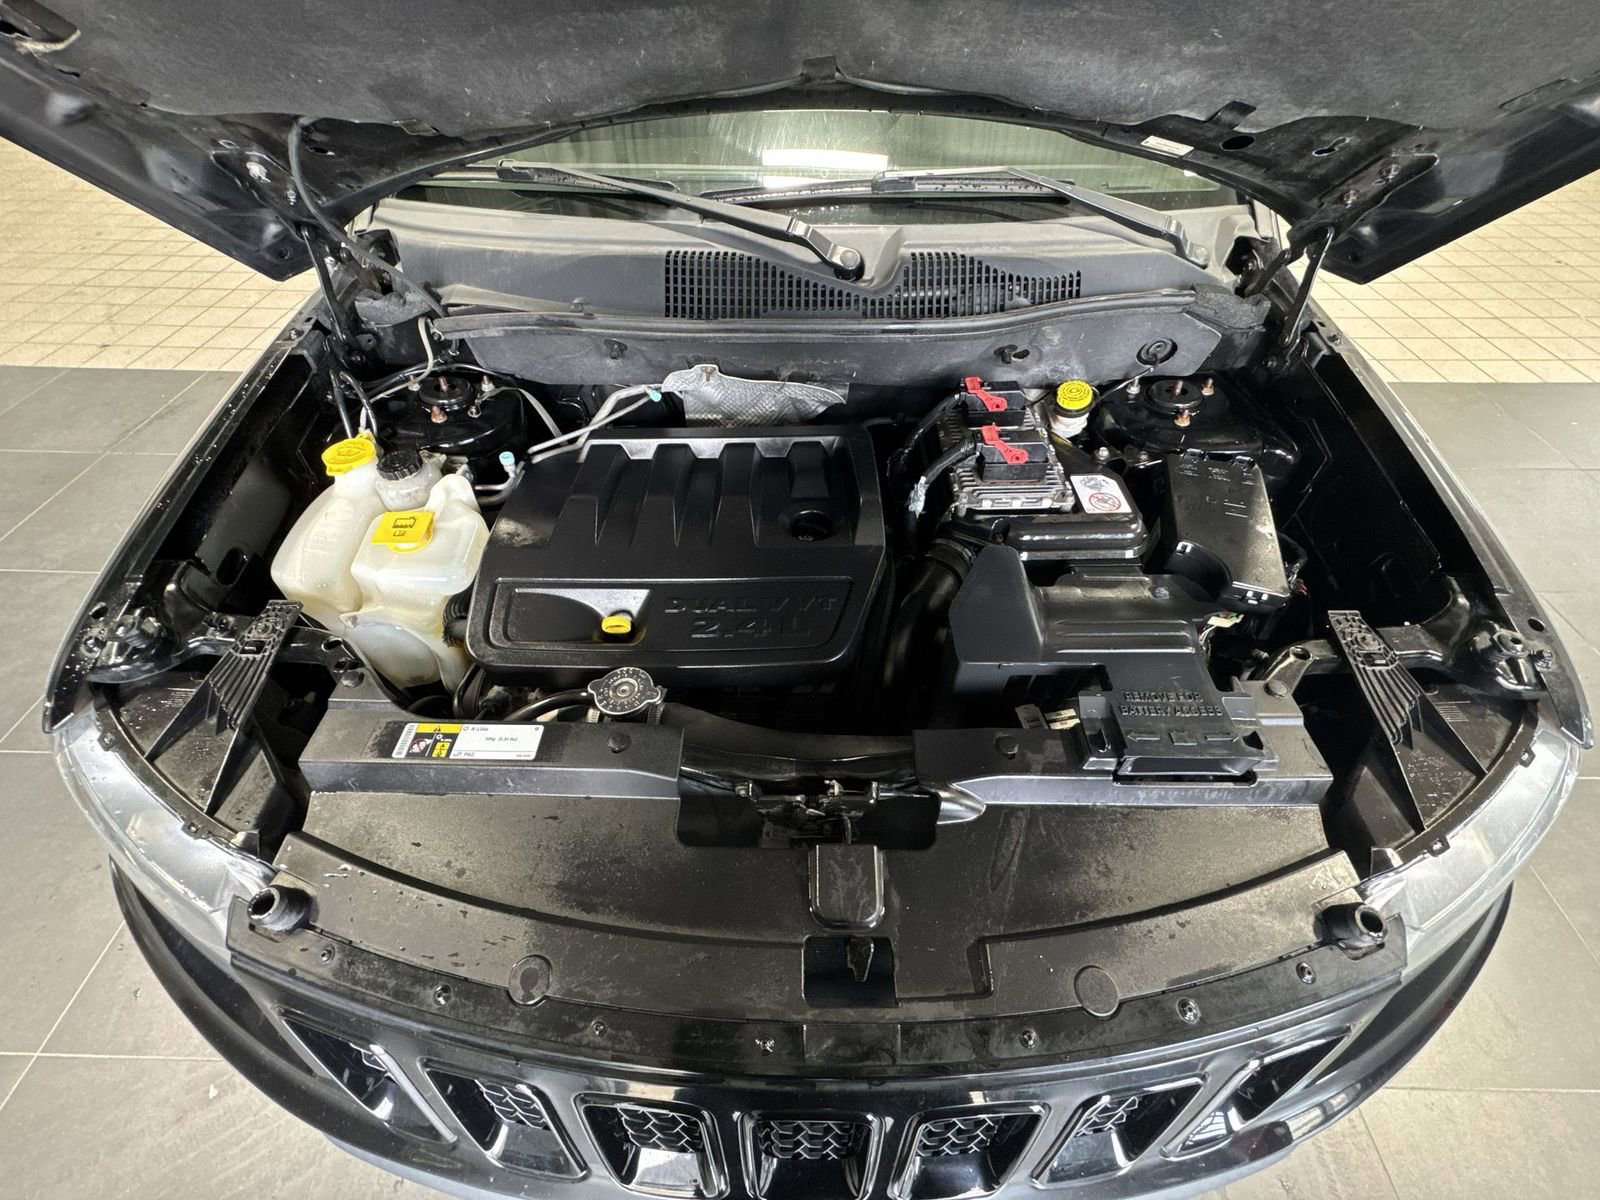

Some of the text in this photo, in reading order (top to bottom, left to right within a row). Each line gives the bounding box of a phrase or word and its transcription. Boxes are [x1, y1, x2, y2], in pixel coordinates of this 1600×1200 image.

[664, 597, 757, 613] DUAL
[1122, 691, 1203, 703] REMOVE FOR
[1119, 705, 1223, 717] BATTERY ACCESS
